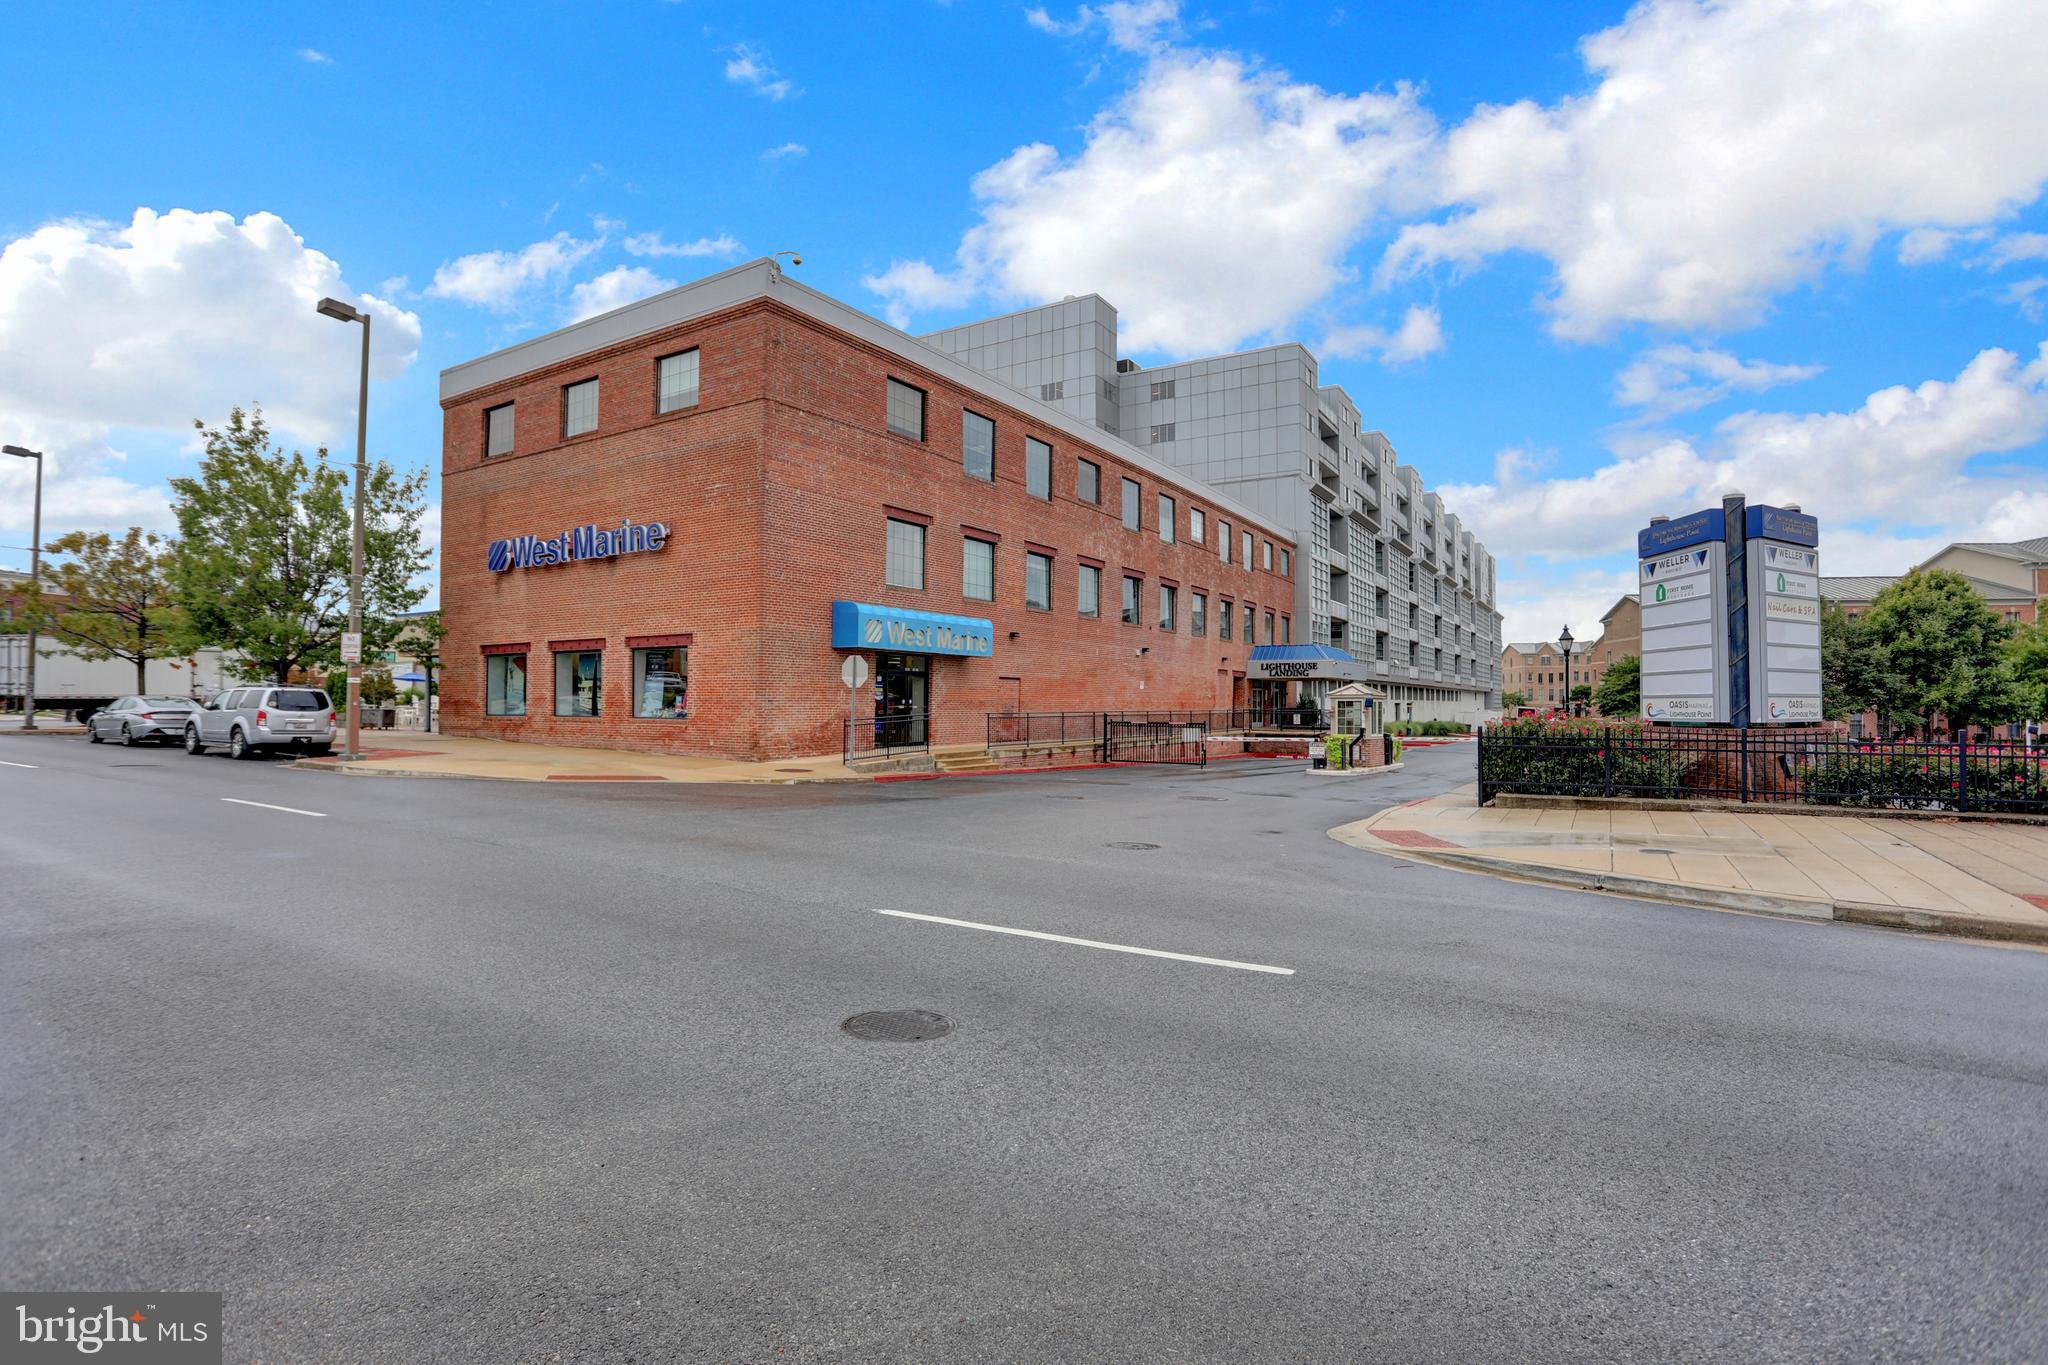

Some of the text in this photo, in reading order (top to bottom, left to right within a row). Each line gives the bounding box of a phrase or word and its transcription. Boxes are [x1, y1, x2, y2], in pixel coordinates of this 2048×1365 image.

[512, 519, 666, 568] West Marine
[1778, 548, 1803, 560] WELLER
[1659, 554, 1690, 569] WELLER
[1803, 606, 1816, 616] SPA
[887, 621, 989, 653] West Marine
[1261, 662, 1318, 670] LIGHTHOUSE
[1269, 669, 1310, 677] LANDING
[1669, 701, 1689, 709] OASIS
[1788, 700, 1803, 709] OASIS
